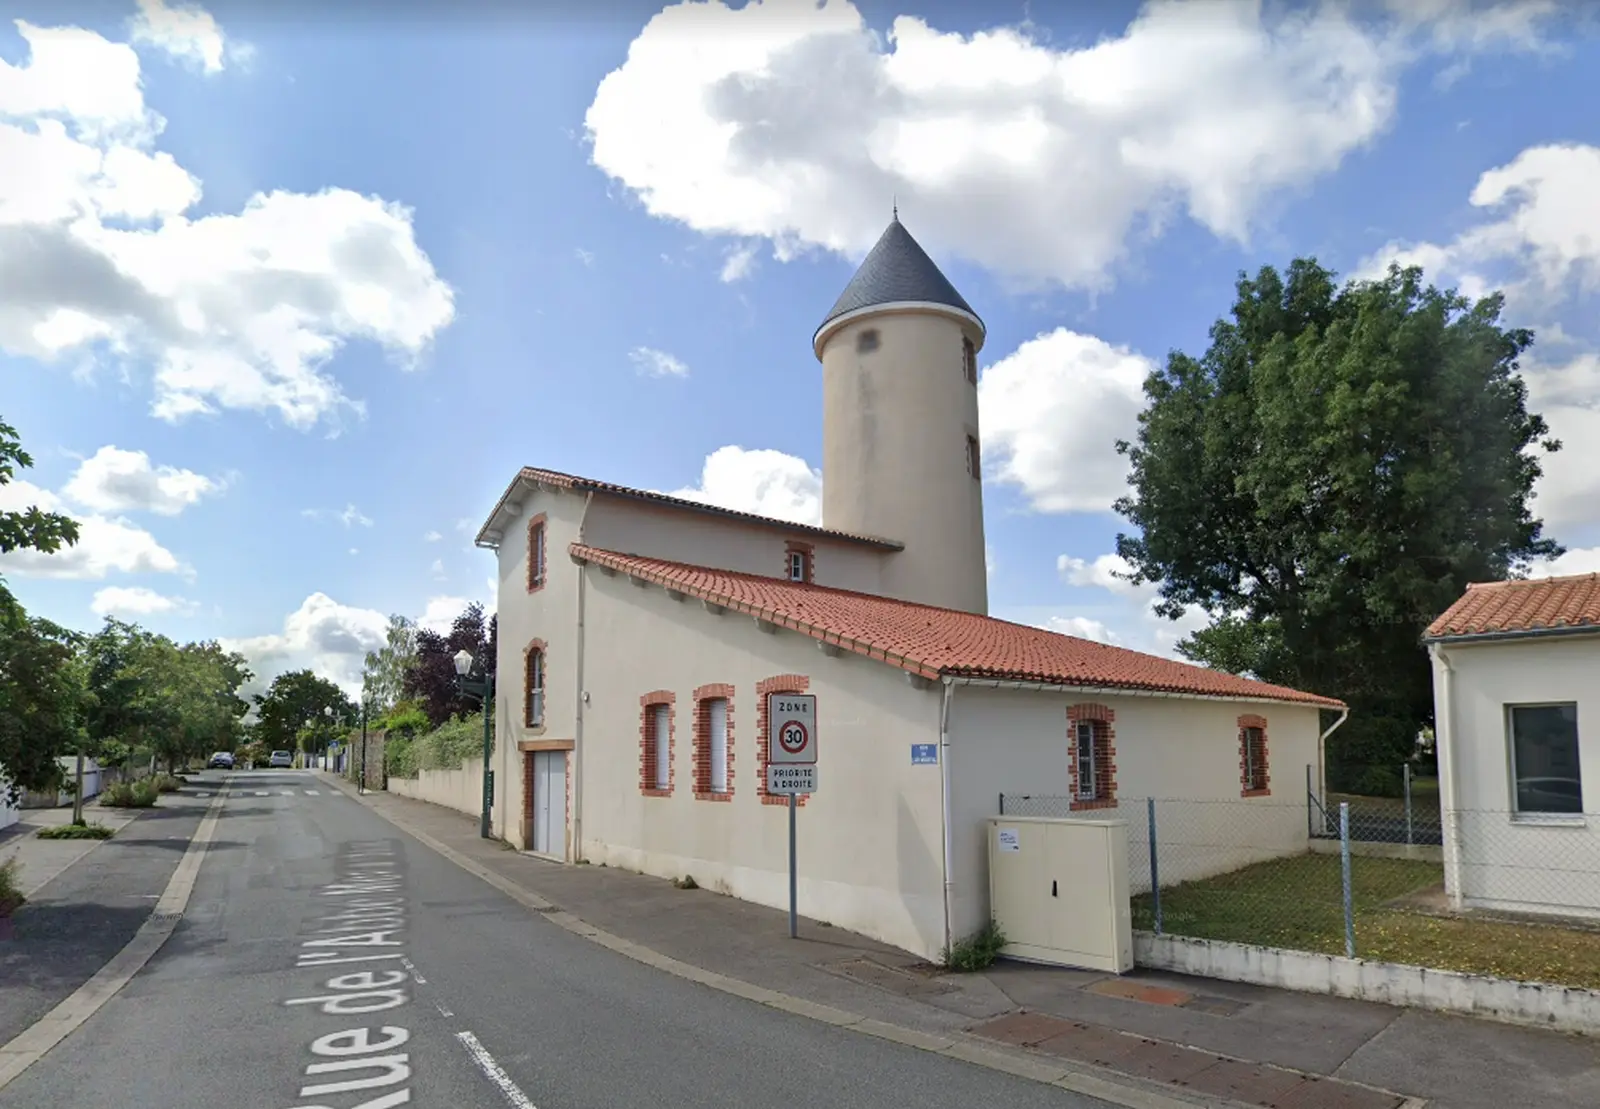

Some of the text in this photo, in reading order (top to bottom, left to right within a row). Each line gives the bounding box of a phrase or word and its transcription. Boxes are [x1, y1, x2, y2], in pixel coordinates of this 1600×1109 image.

[779, 702, 807, 713] ZONE
[785, 729, 802, 743] 30
[782, 780, 812, 788] DROITE
